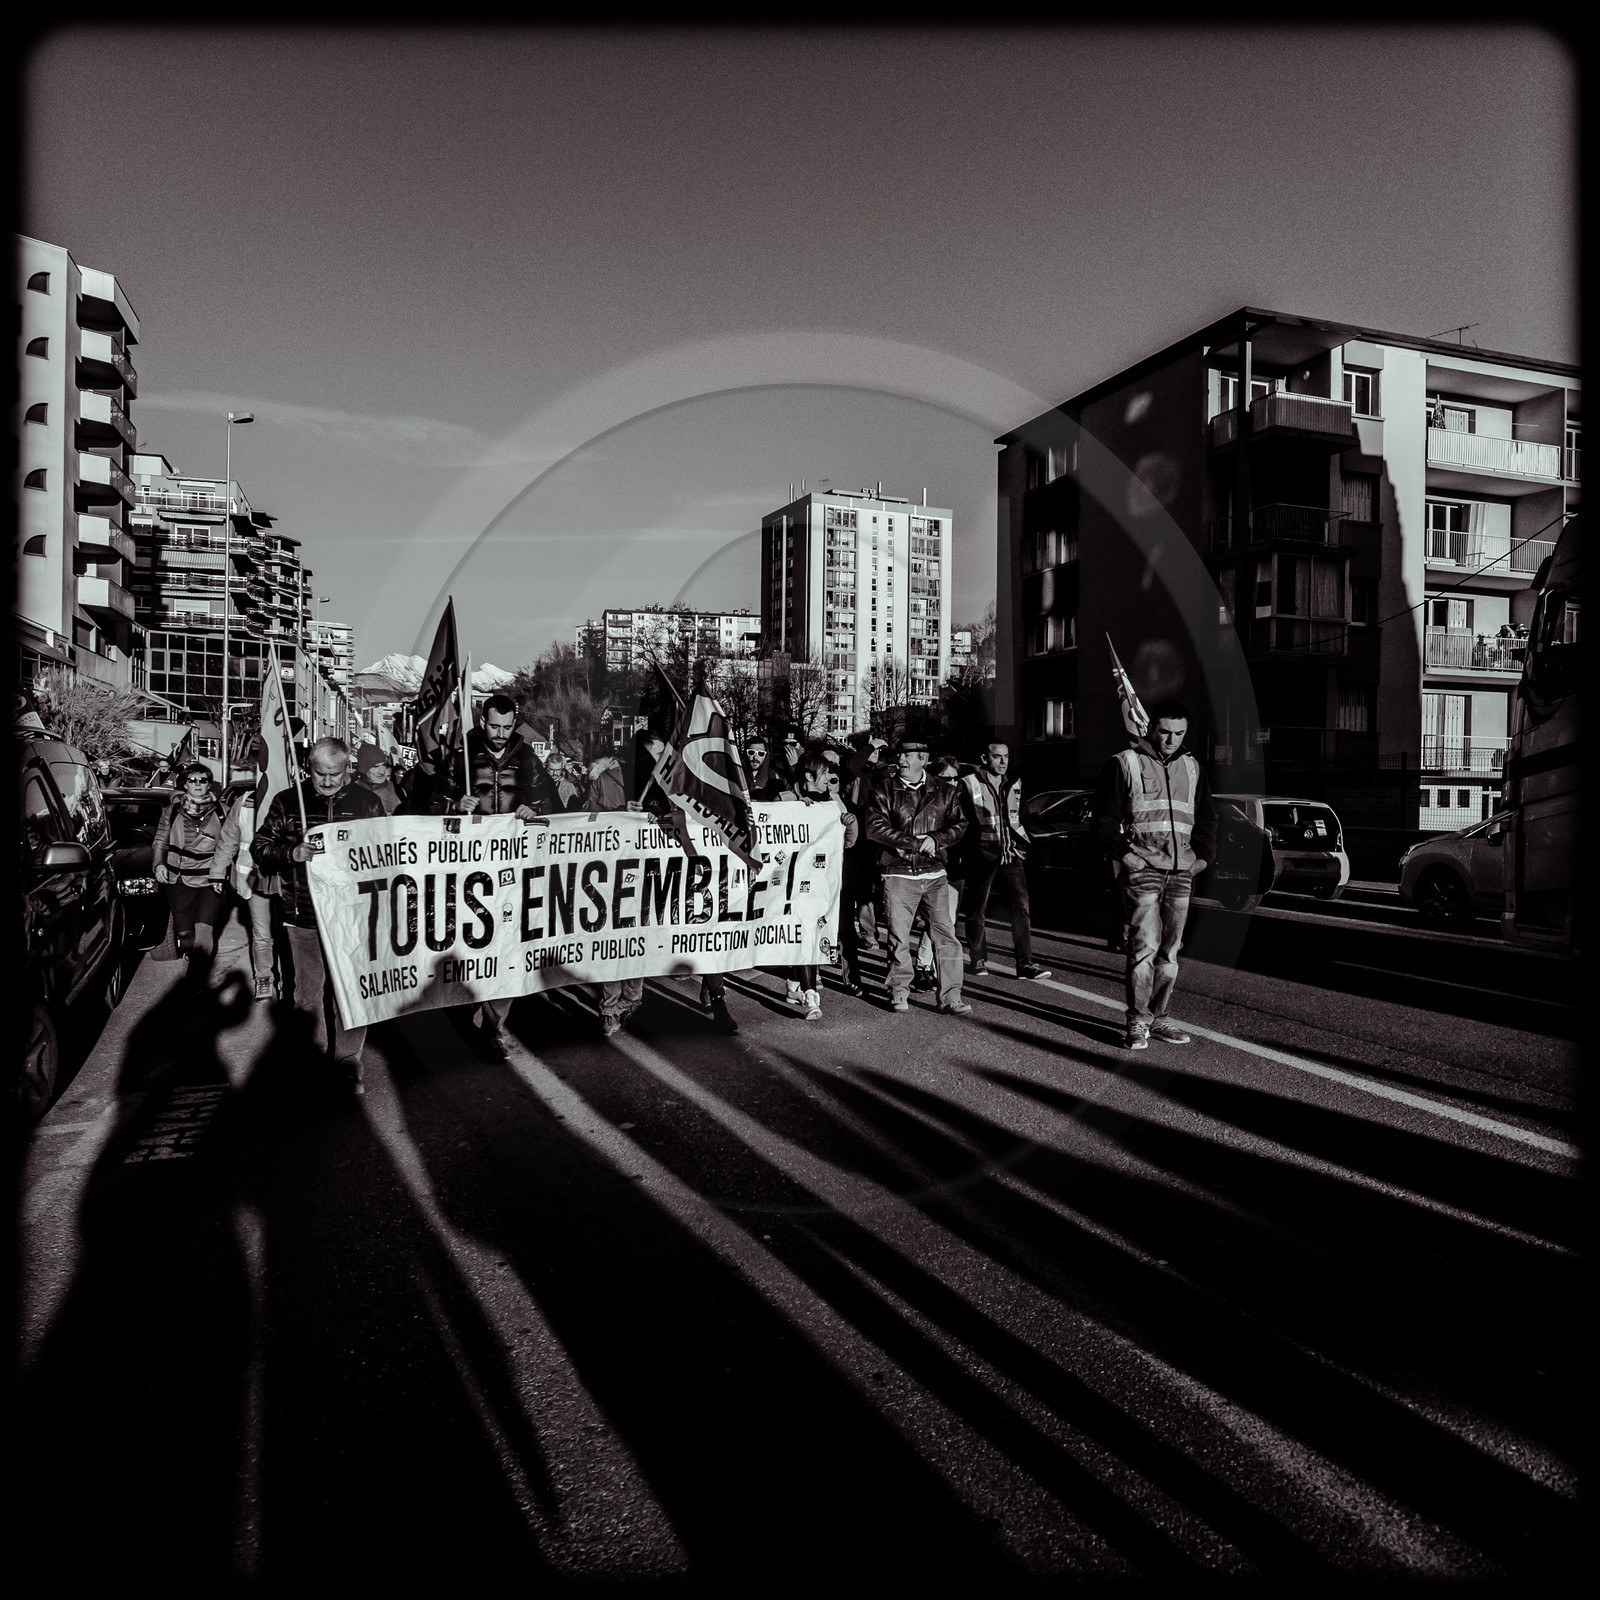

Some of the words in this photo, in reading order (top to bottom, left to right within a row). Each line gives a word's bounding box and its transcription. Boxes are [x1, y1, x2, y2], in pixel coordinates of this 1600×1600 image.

[349, 837, 418, 871] SALARIÉS
[549, 825, 620, 854] RETRAITÉS
[635, 827, 682, 850] JEUNES
[501, 869, 514, 883] FO
[357, 871, 495, 962] TOUS
[521, 854, 768, 943] ENSEMBLE
[359, 965, 418, 1000] SALAIRES
[443, 956, 497, 983] EMPLOI
[525, 942, 584, 972] SERVICES
[591, 936, 645, 961] PUBLICS
[672, 930, 749, 953] PROTECTION
[754, 924, 802, 947] SOCIALE
